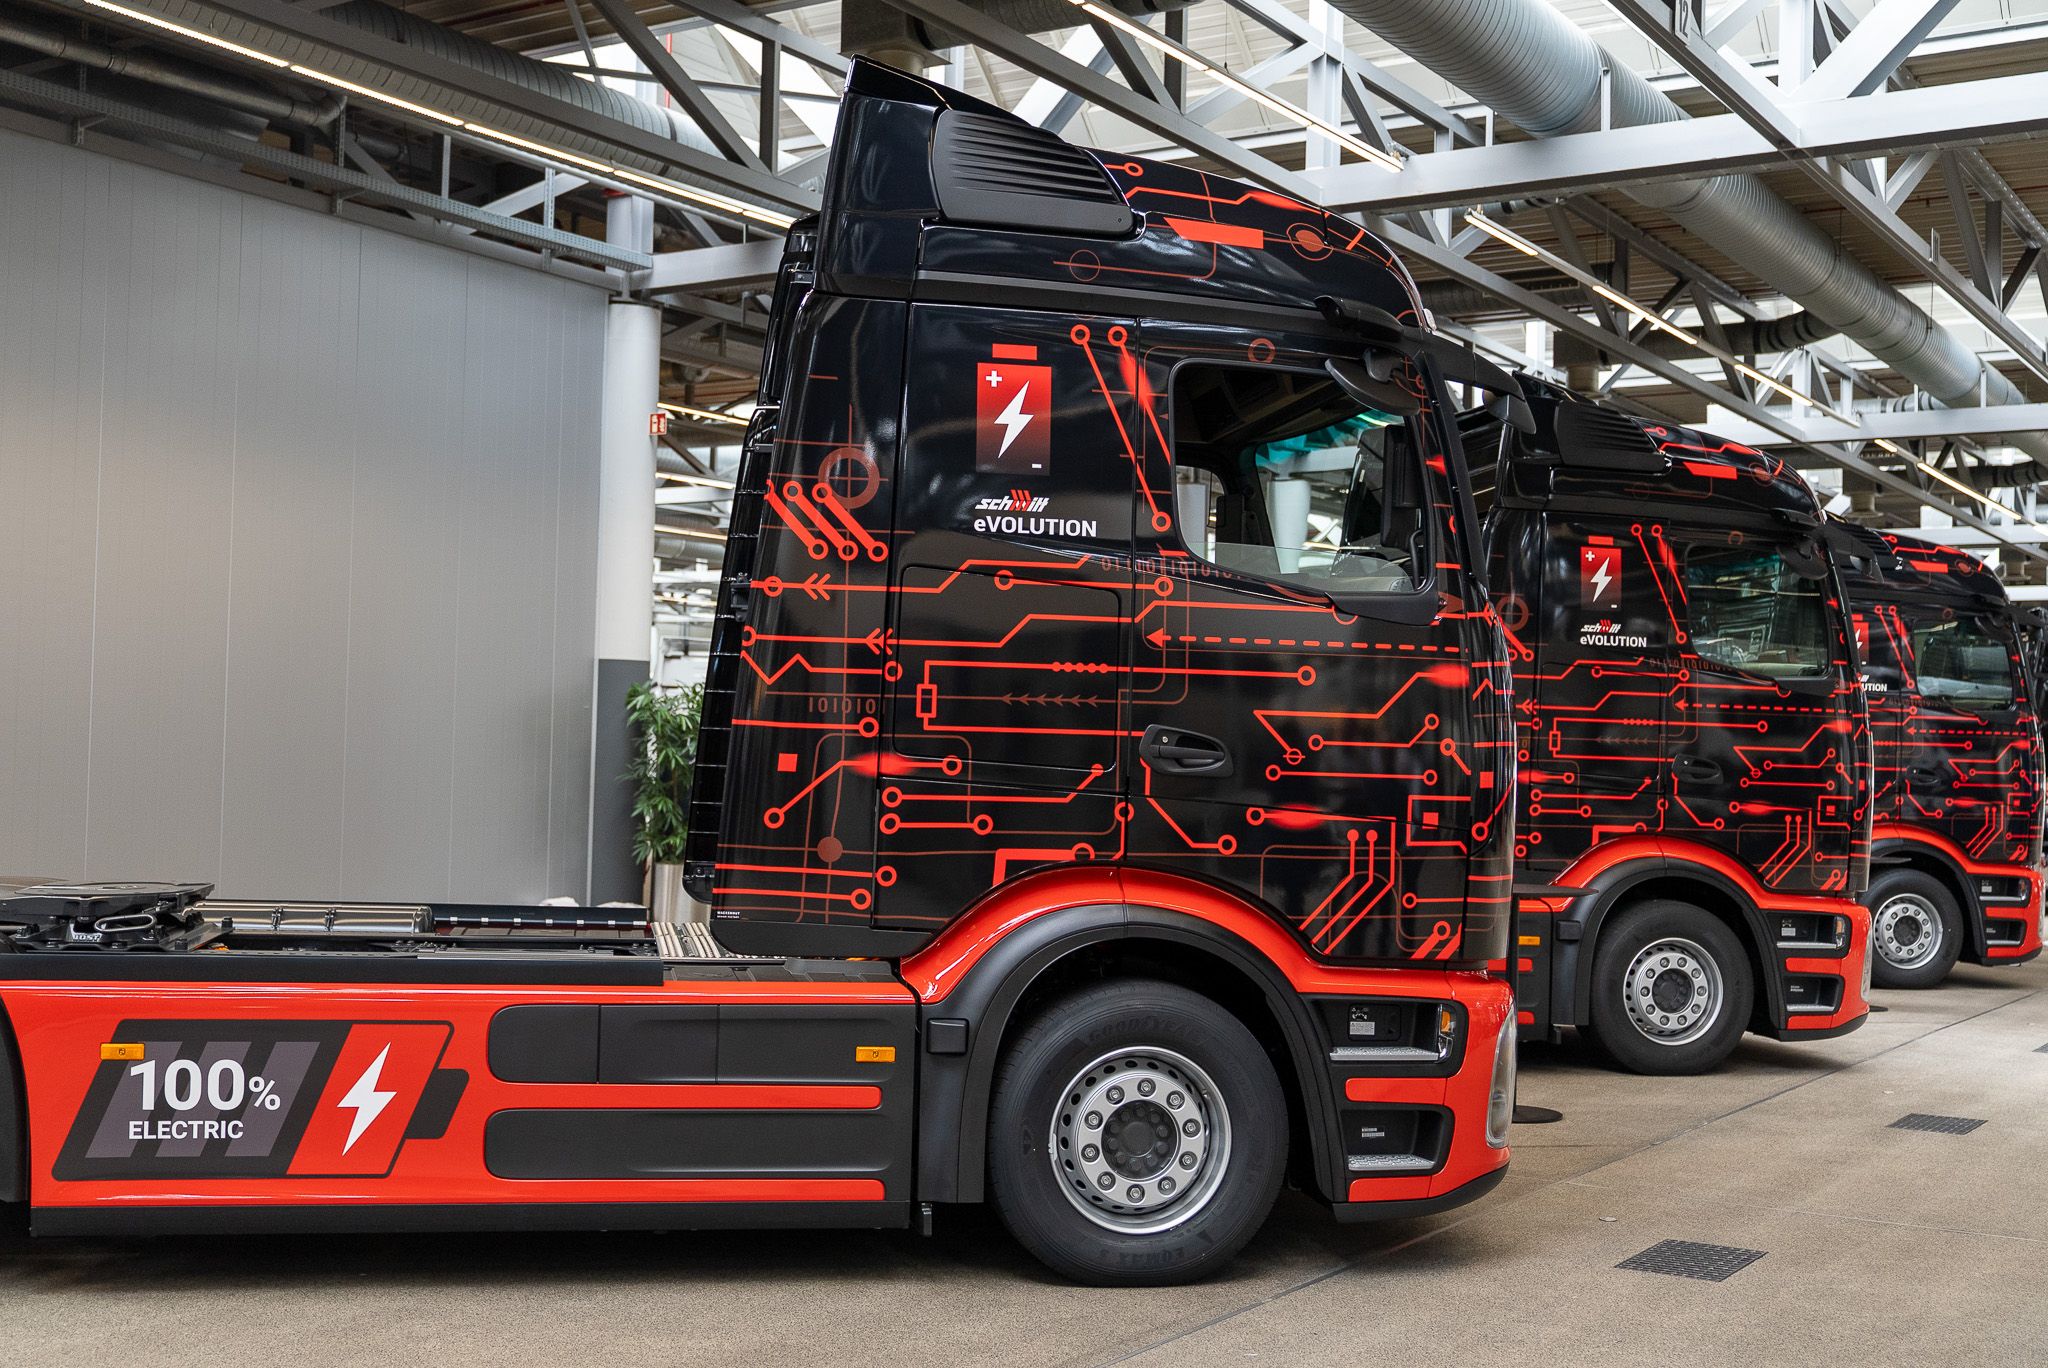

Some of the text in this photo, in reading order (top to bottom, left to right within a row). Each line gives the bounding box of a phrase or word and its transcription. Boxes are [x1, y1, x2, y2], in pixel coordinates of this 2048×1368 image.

[1679, 0, 1688, 38] 12
[974, 516, 1097, 537] eVOLUTION
[1580, 634, 1647, 648] eVOLUTION
[1861, 683, 1887, 692] UTION
[130, 1059, 281, 1111] 100%
[128, 1120, 244, 1140] ELECTRIC
